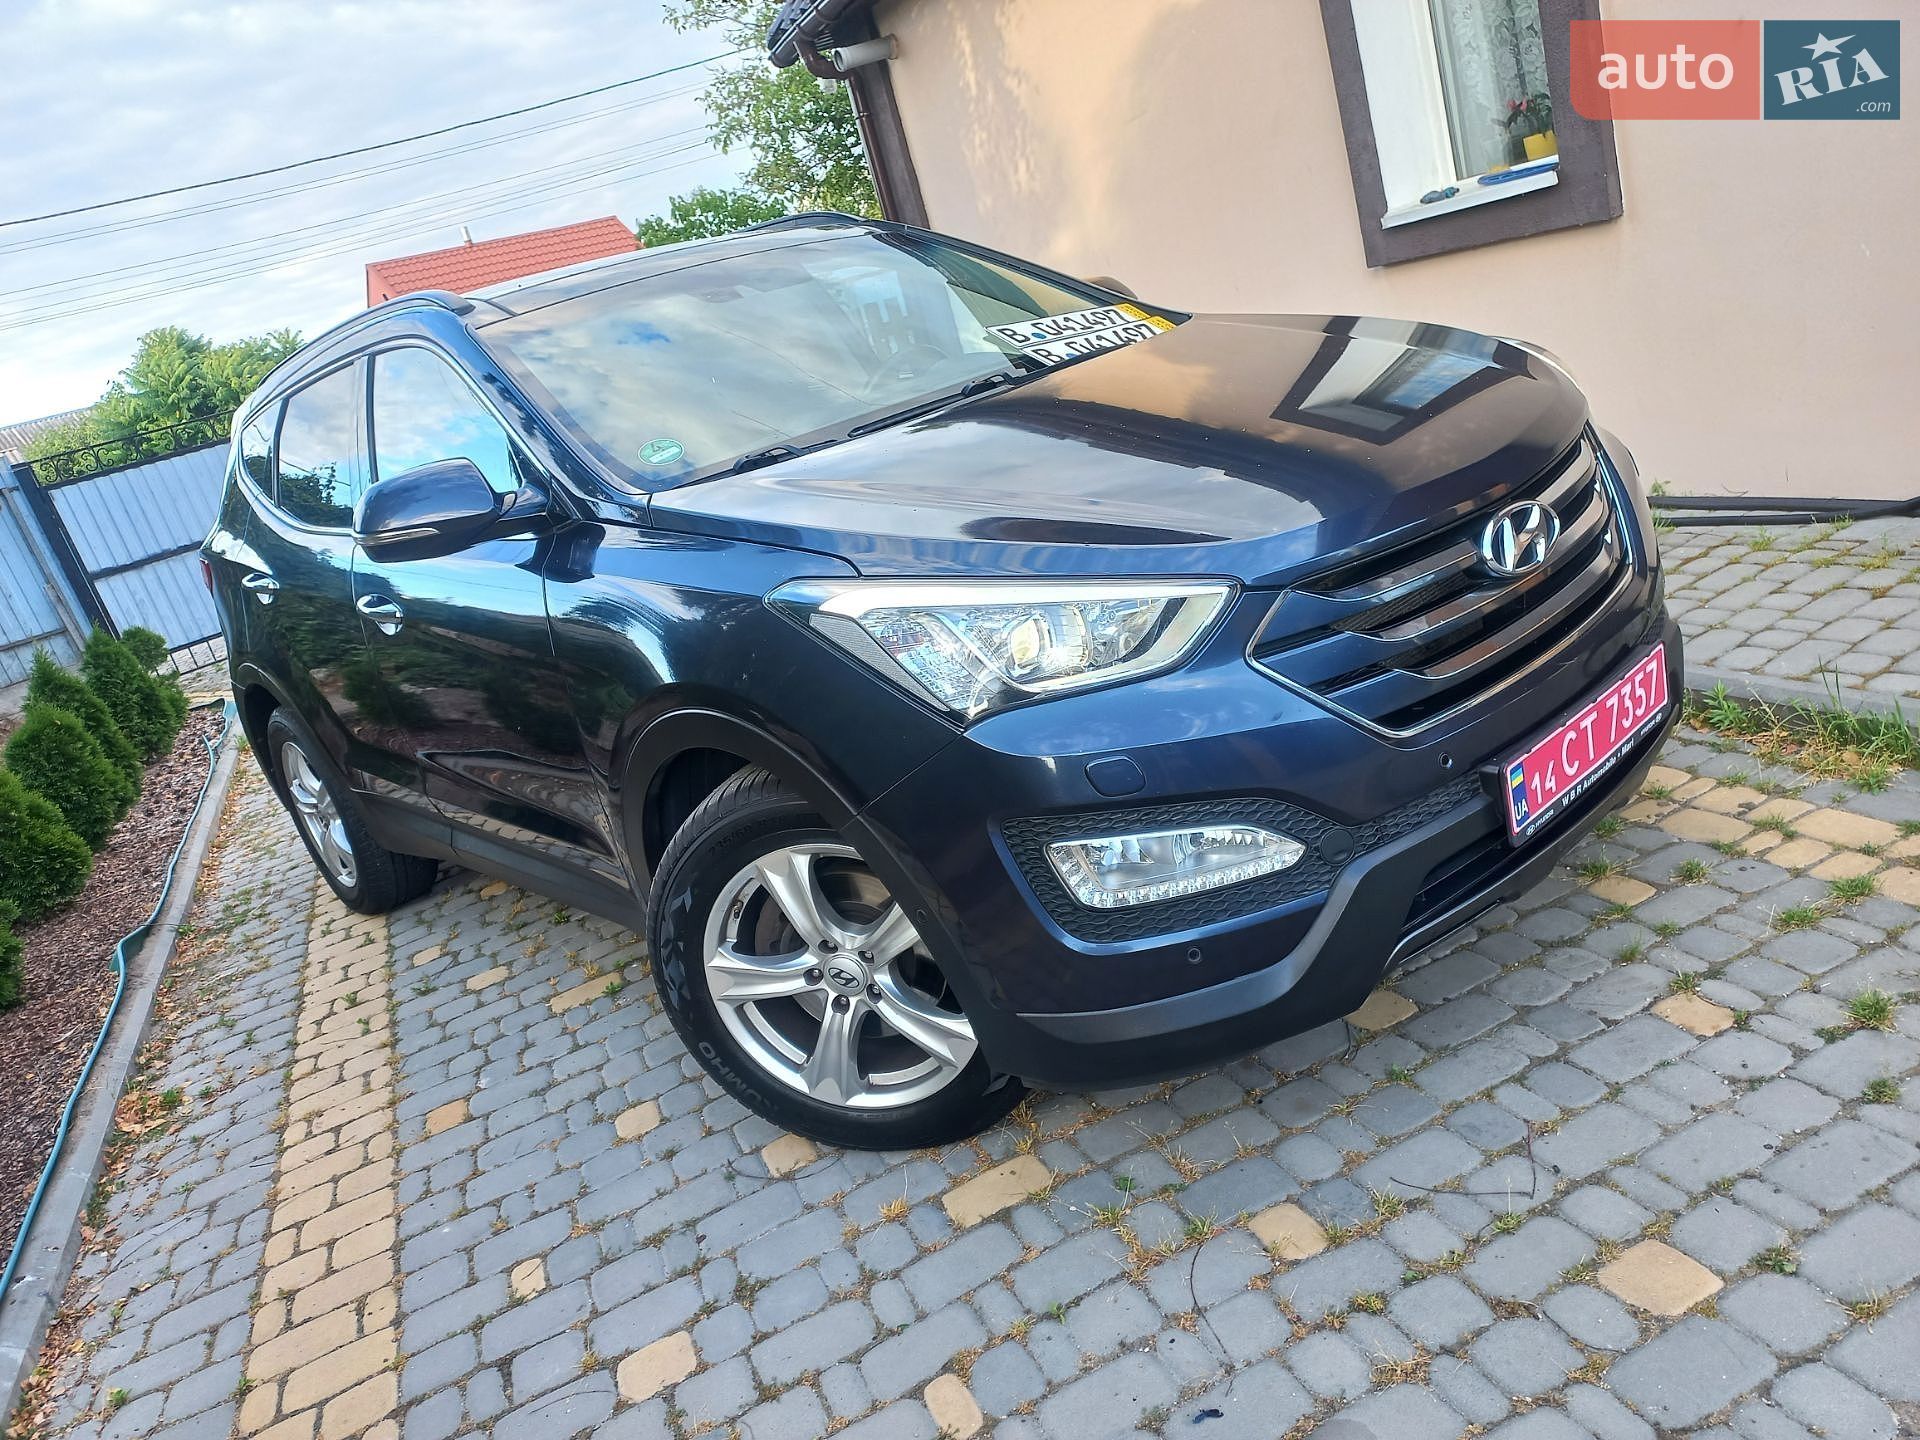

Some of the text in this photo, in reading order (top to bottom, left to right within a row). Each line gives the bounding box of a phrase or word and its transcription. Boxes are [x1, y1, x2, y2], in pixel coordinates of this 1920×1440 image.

[996, 327, 1031, 345] B
[1032, 348, 1065, 364] B
[1530, 659, 1658, 804] 14 CT 7357
[1514, 801, 1529, 821] UA
